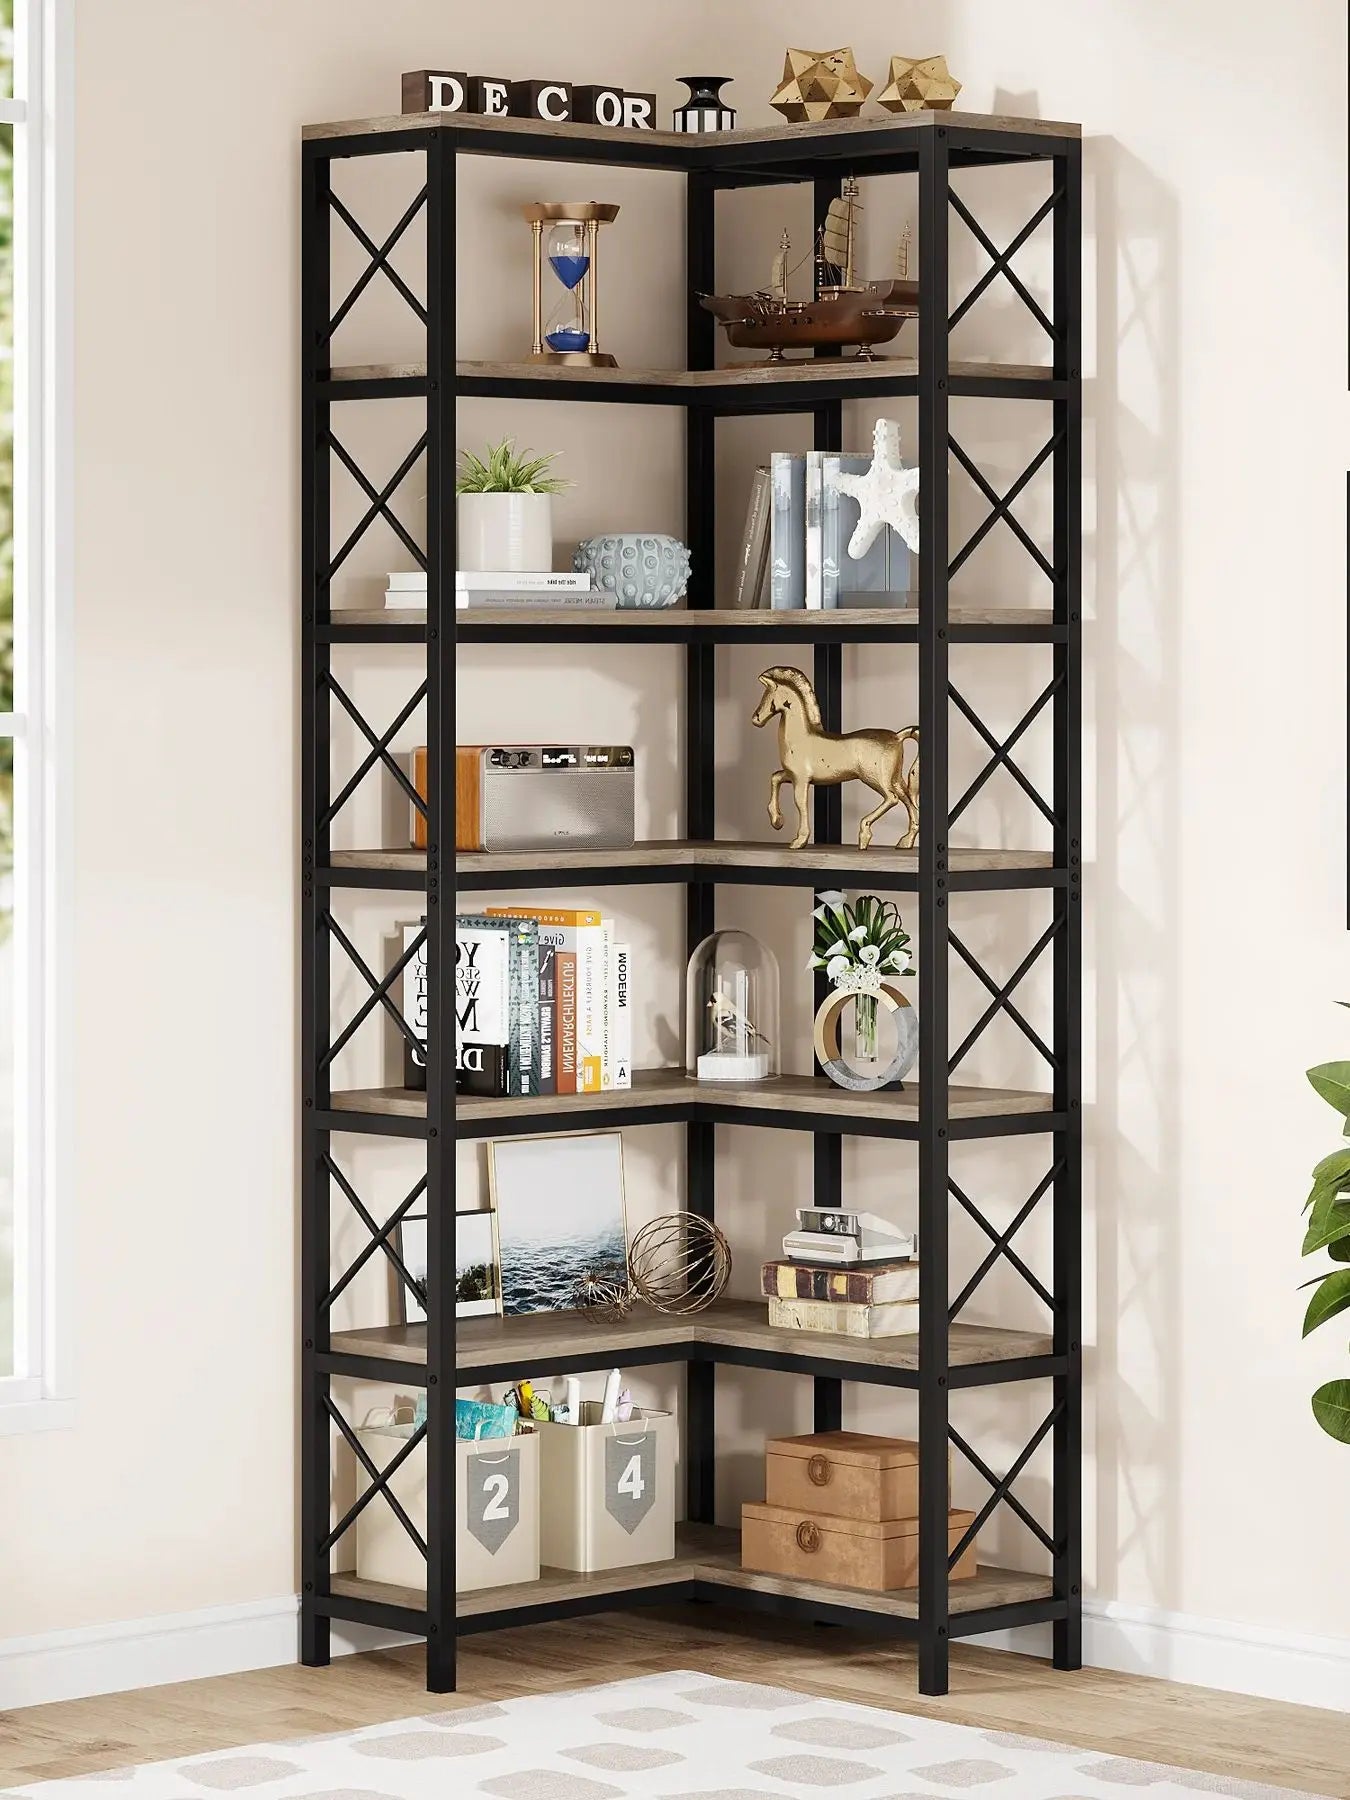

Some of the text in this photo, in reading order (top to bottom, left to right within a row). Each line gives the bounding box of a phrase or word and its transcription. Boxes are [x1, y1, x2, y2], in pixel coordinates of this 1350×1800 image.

[428, 75, 654, 130] DECOR
[482, 1473, 510, 1521] 2
[617, 1454, 645, 1500] 4
